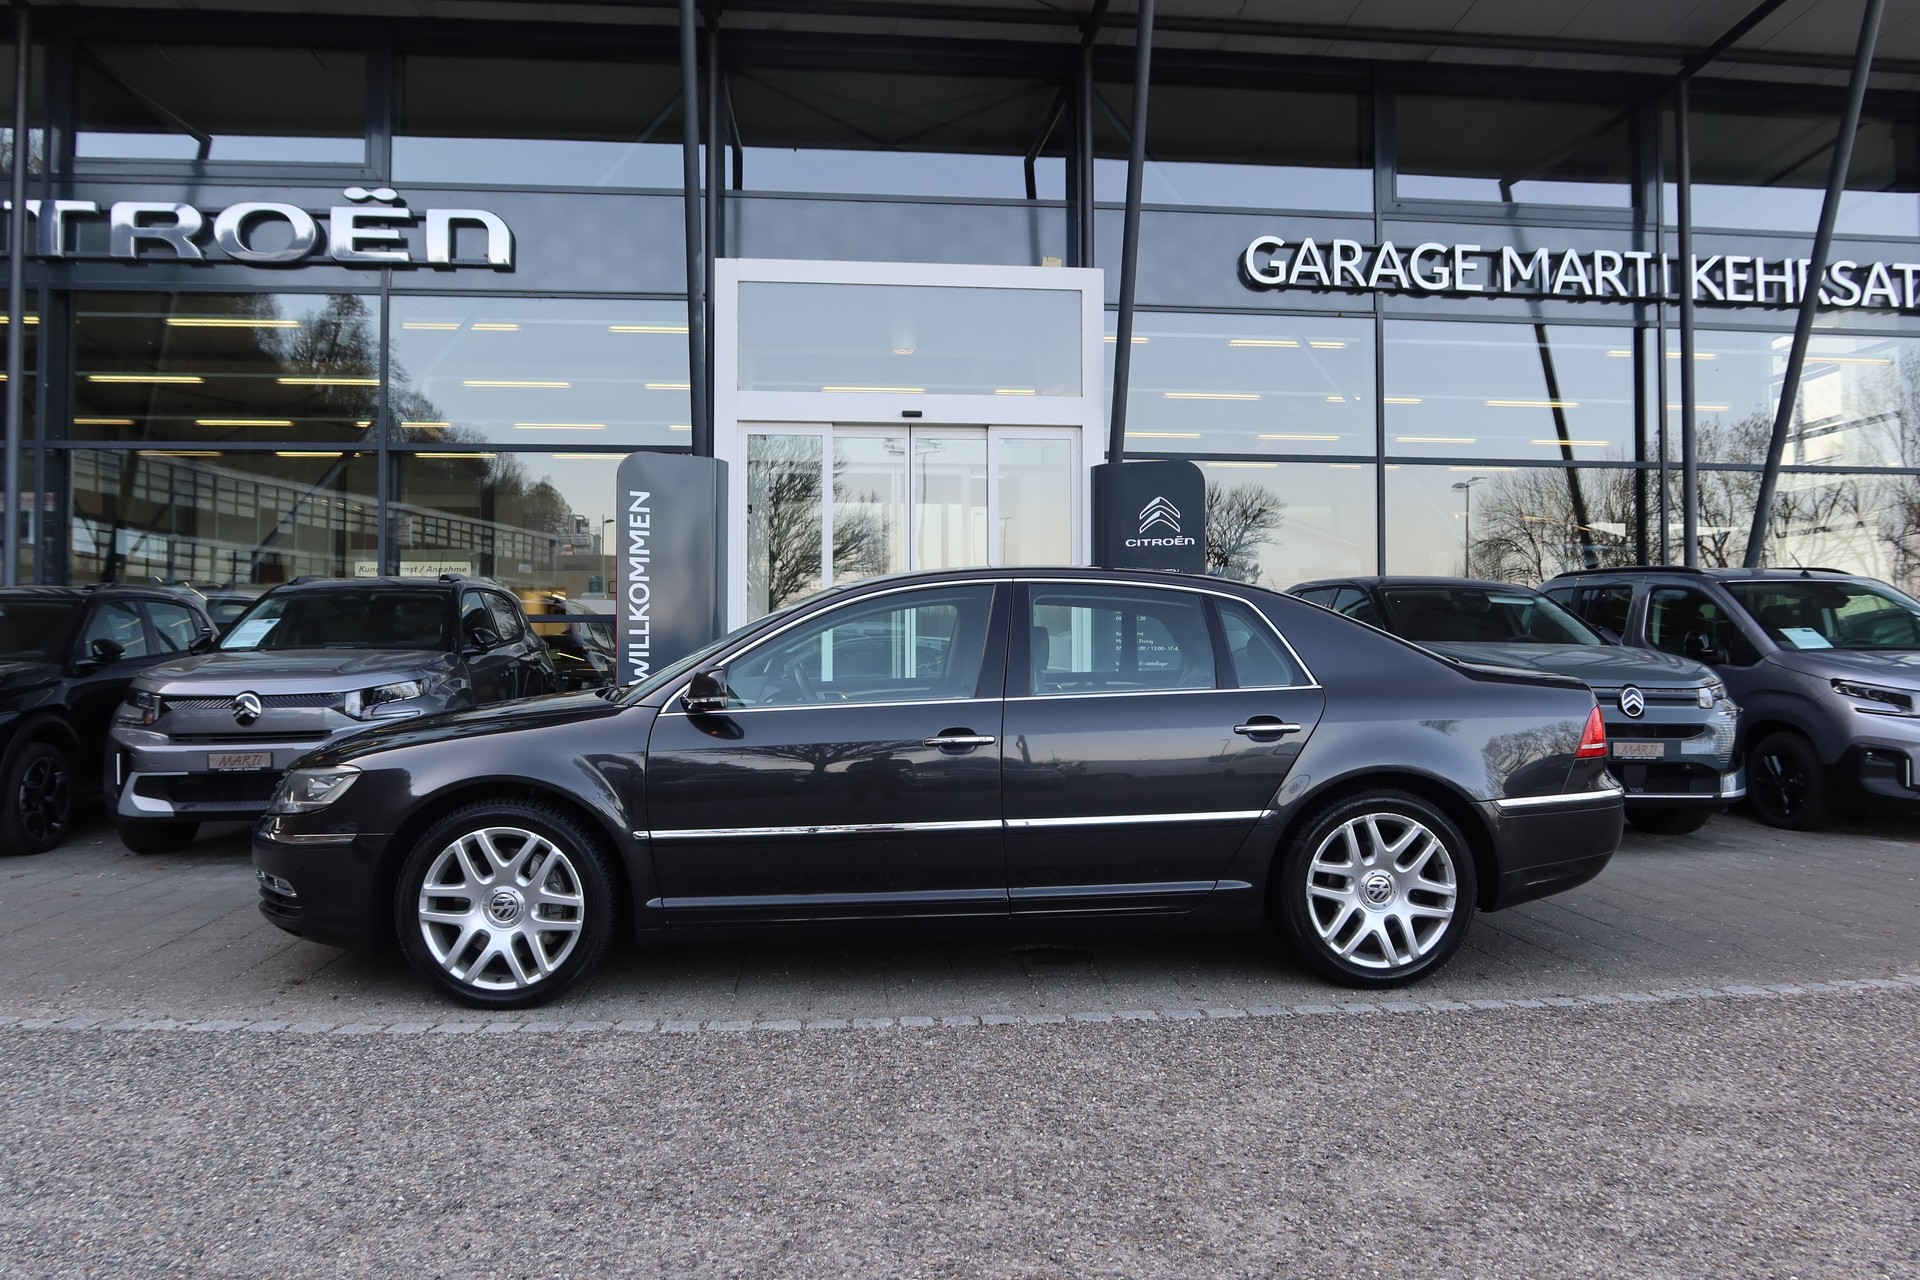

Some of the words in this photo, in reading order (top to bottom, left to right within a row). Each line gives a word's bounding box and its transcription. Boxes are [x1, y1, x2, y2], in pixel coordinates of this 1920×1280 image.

[1245, 235, 1484, 292] GARAGE
[1501, 245, 1669, 298] MARTI
[426, 565, 467, 573] Annahme
[628, 490, 651, 686] WILLKOMMEN
